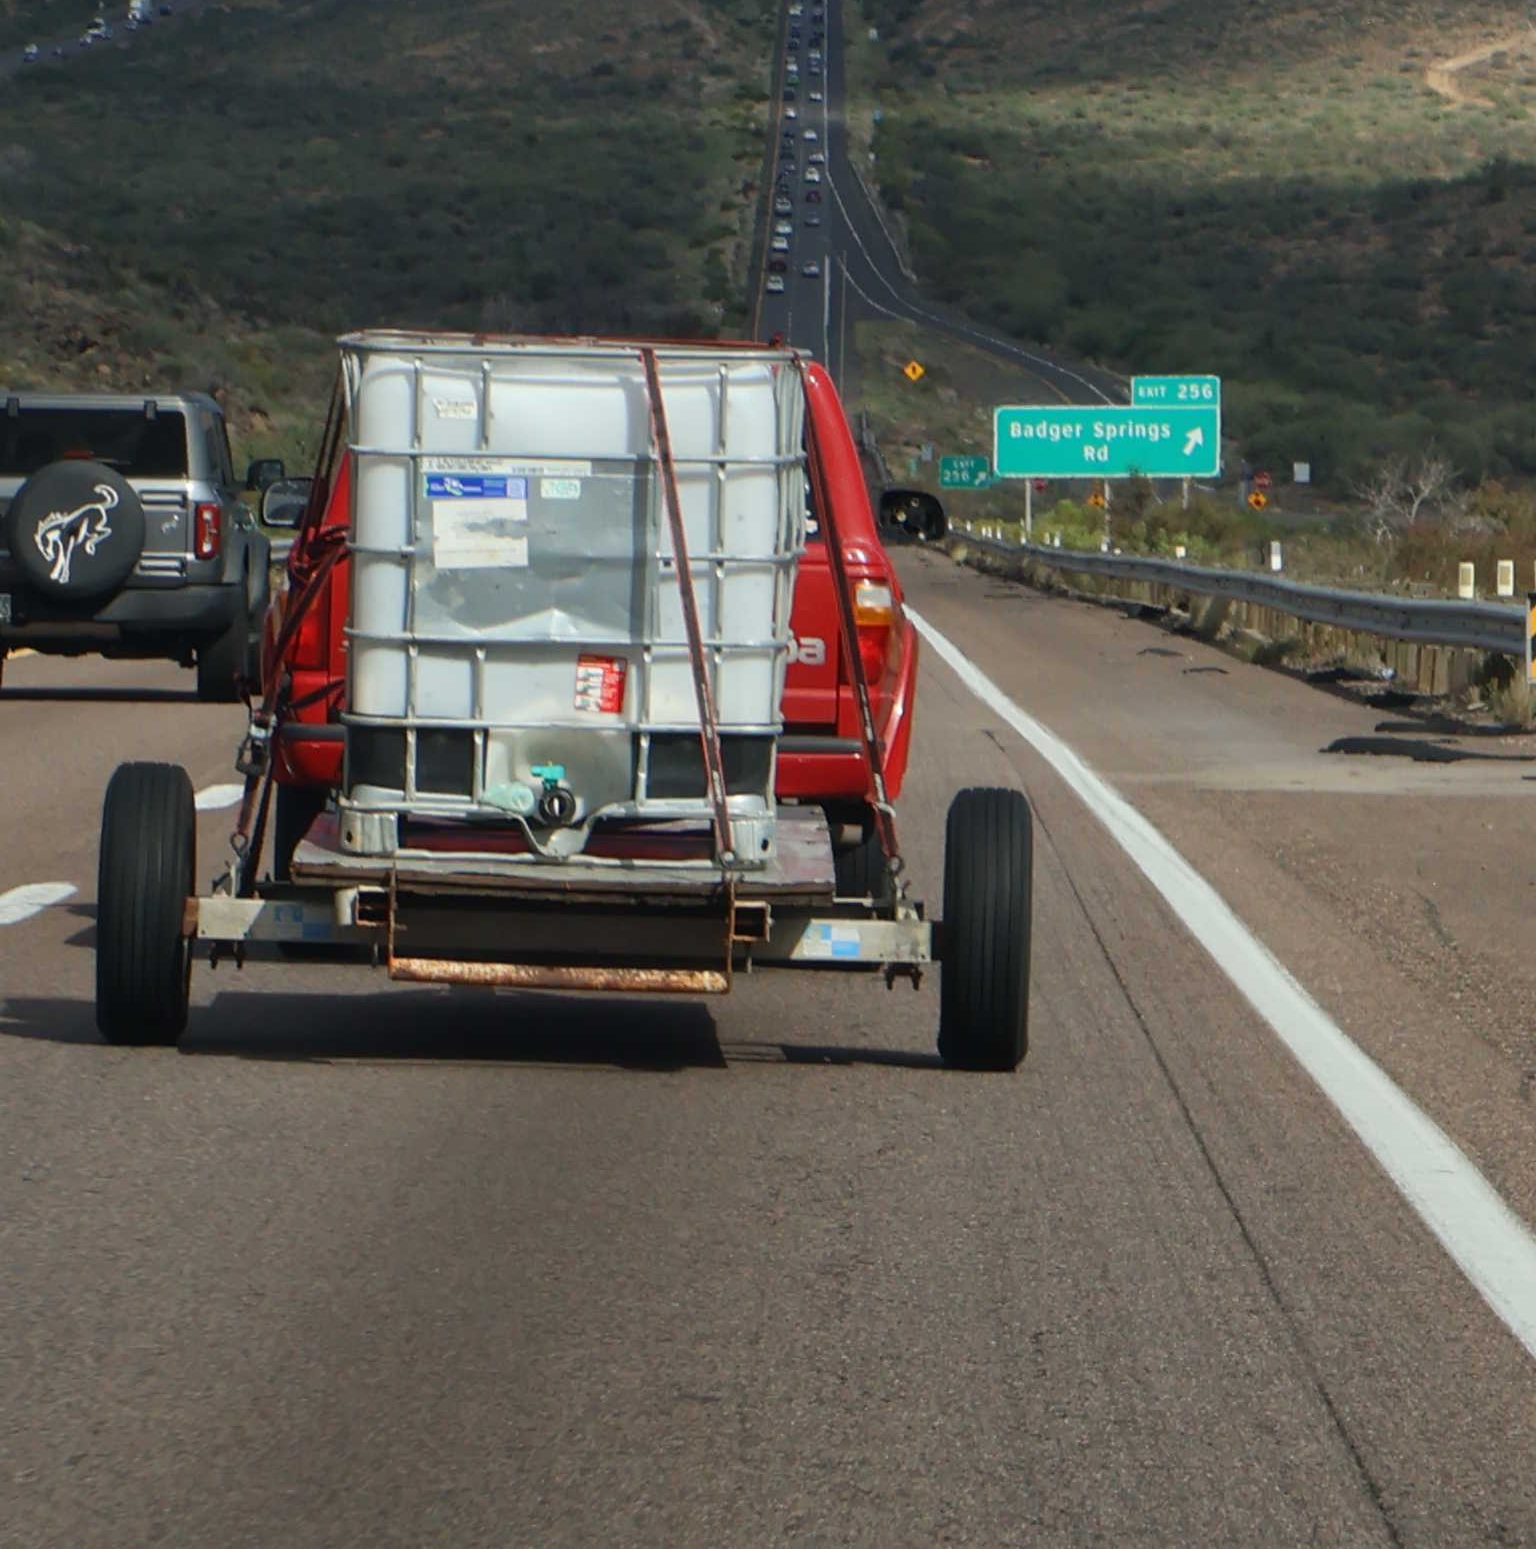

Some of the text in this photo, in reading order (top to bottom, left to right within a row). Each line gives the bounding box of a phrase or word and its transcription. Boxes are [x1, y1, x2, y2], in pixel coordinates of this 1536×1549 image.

[1138, 383, 1214, 400] EXIT 256
[1010, 420, 1172, 442] Badger Springs
[1083, 444, 1109, 462] Rd
